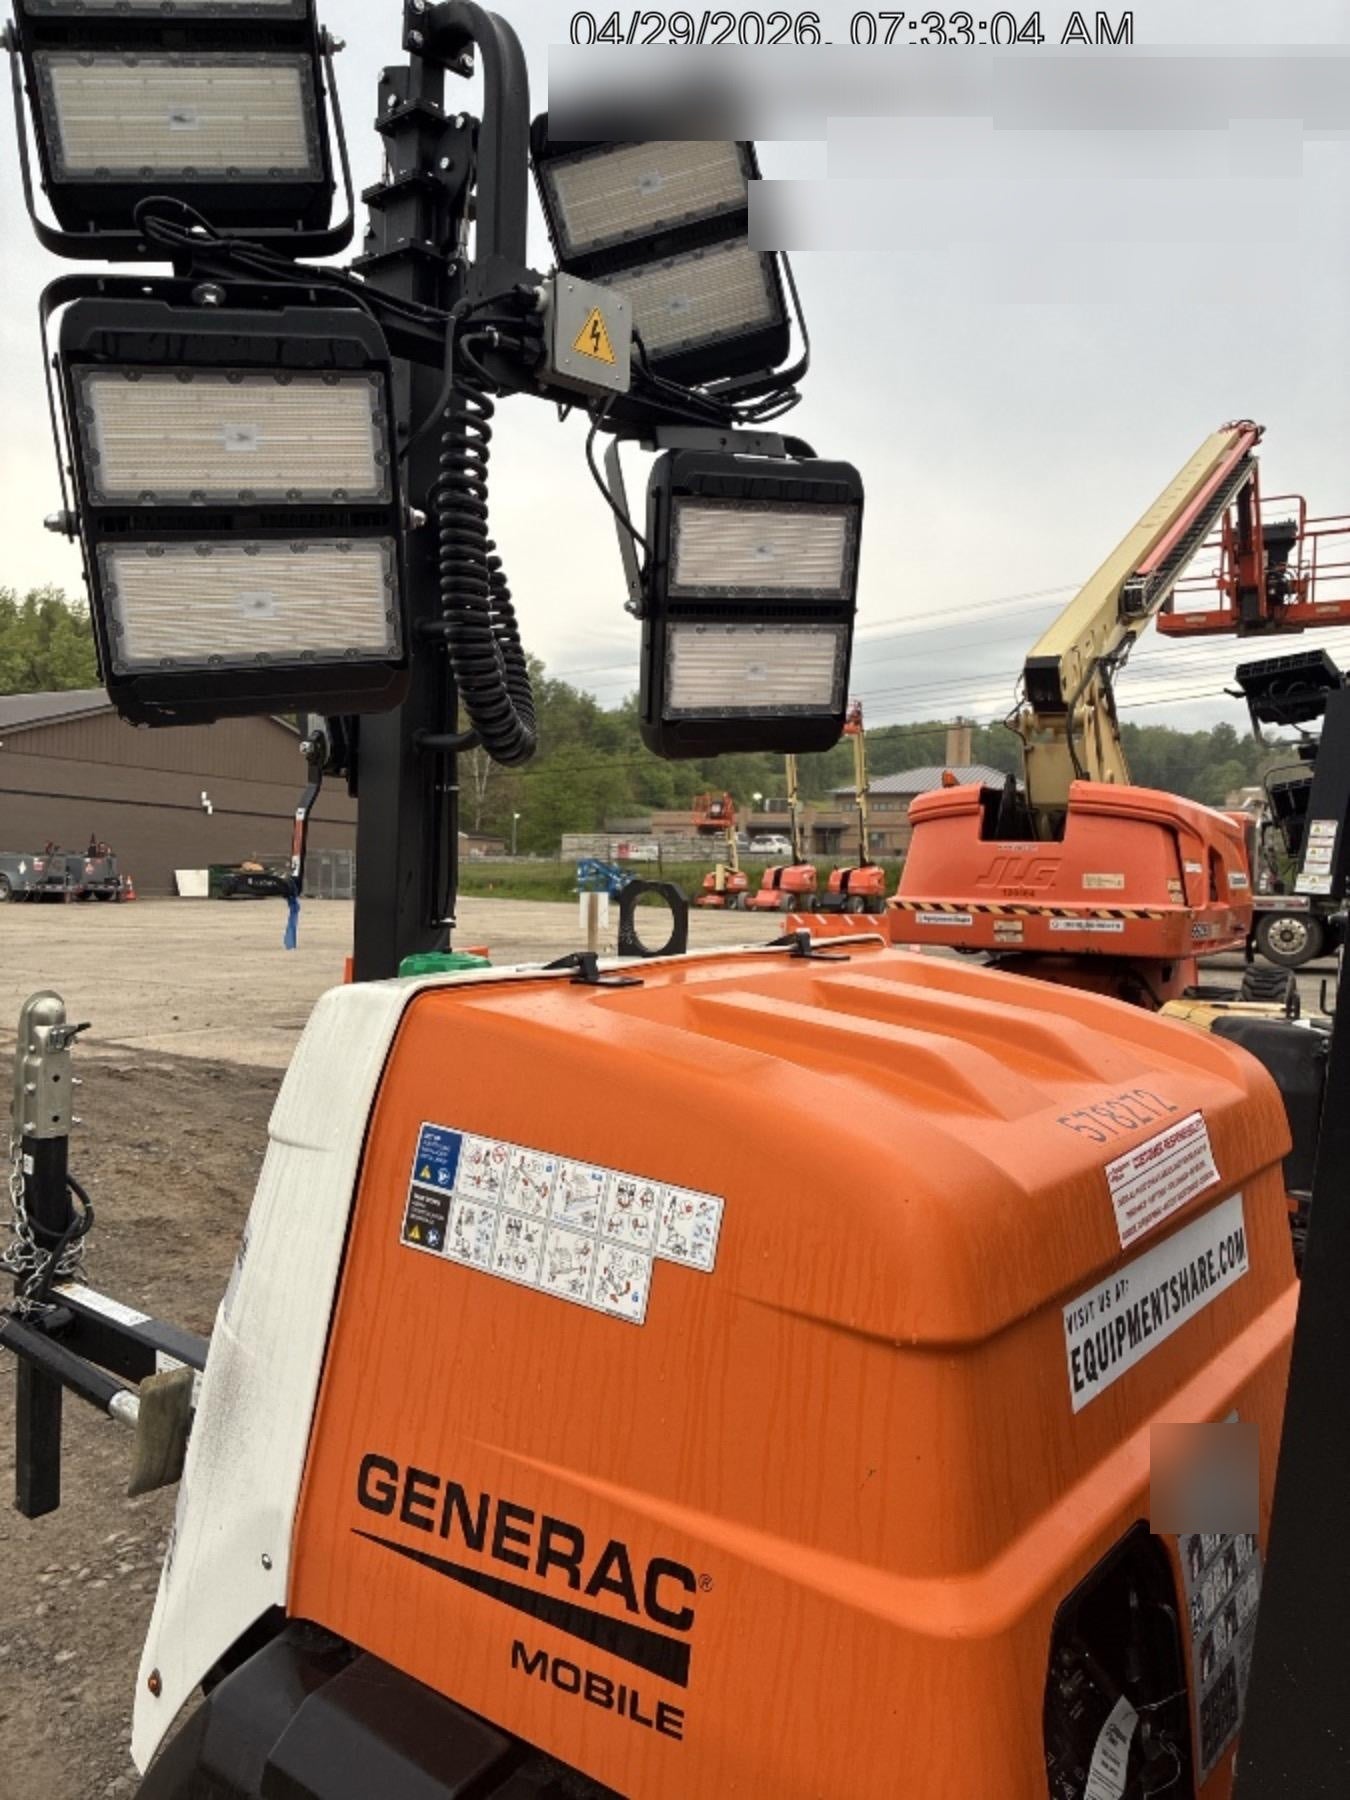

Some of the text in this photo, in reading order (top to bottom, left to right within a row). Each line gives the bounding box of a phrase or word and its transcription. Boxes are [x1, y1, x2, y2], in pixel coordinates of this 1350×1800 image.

[975, 855, 1062, 889] JLG
[1057, 1088, 1179, 1143] 578272
[1066, 1279, 1129, 1336] VISIT US AT:
[1070, 1226, 1246, 1393] EQUIPMENTSHARE.COM
[511, 1639, 686, 1742] MOBILE
